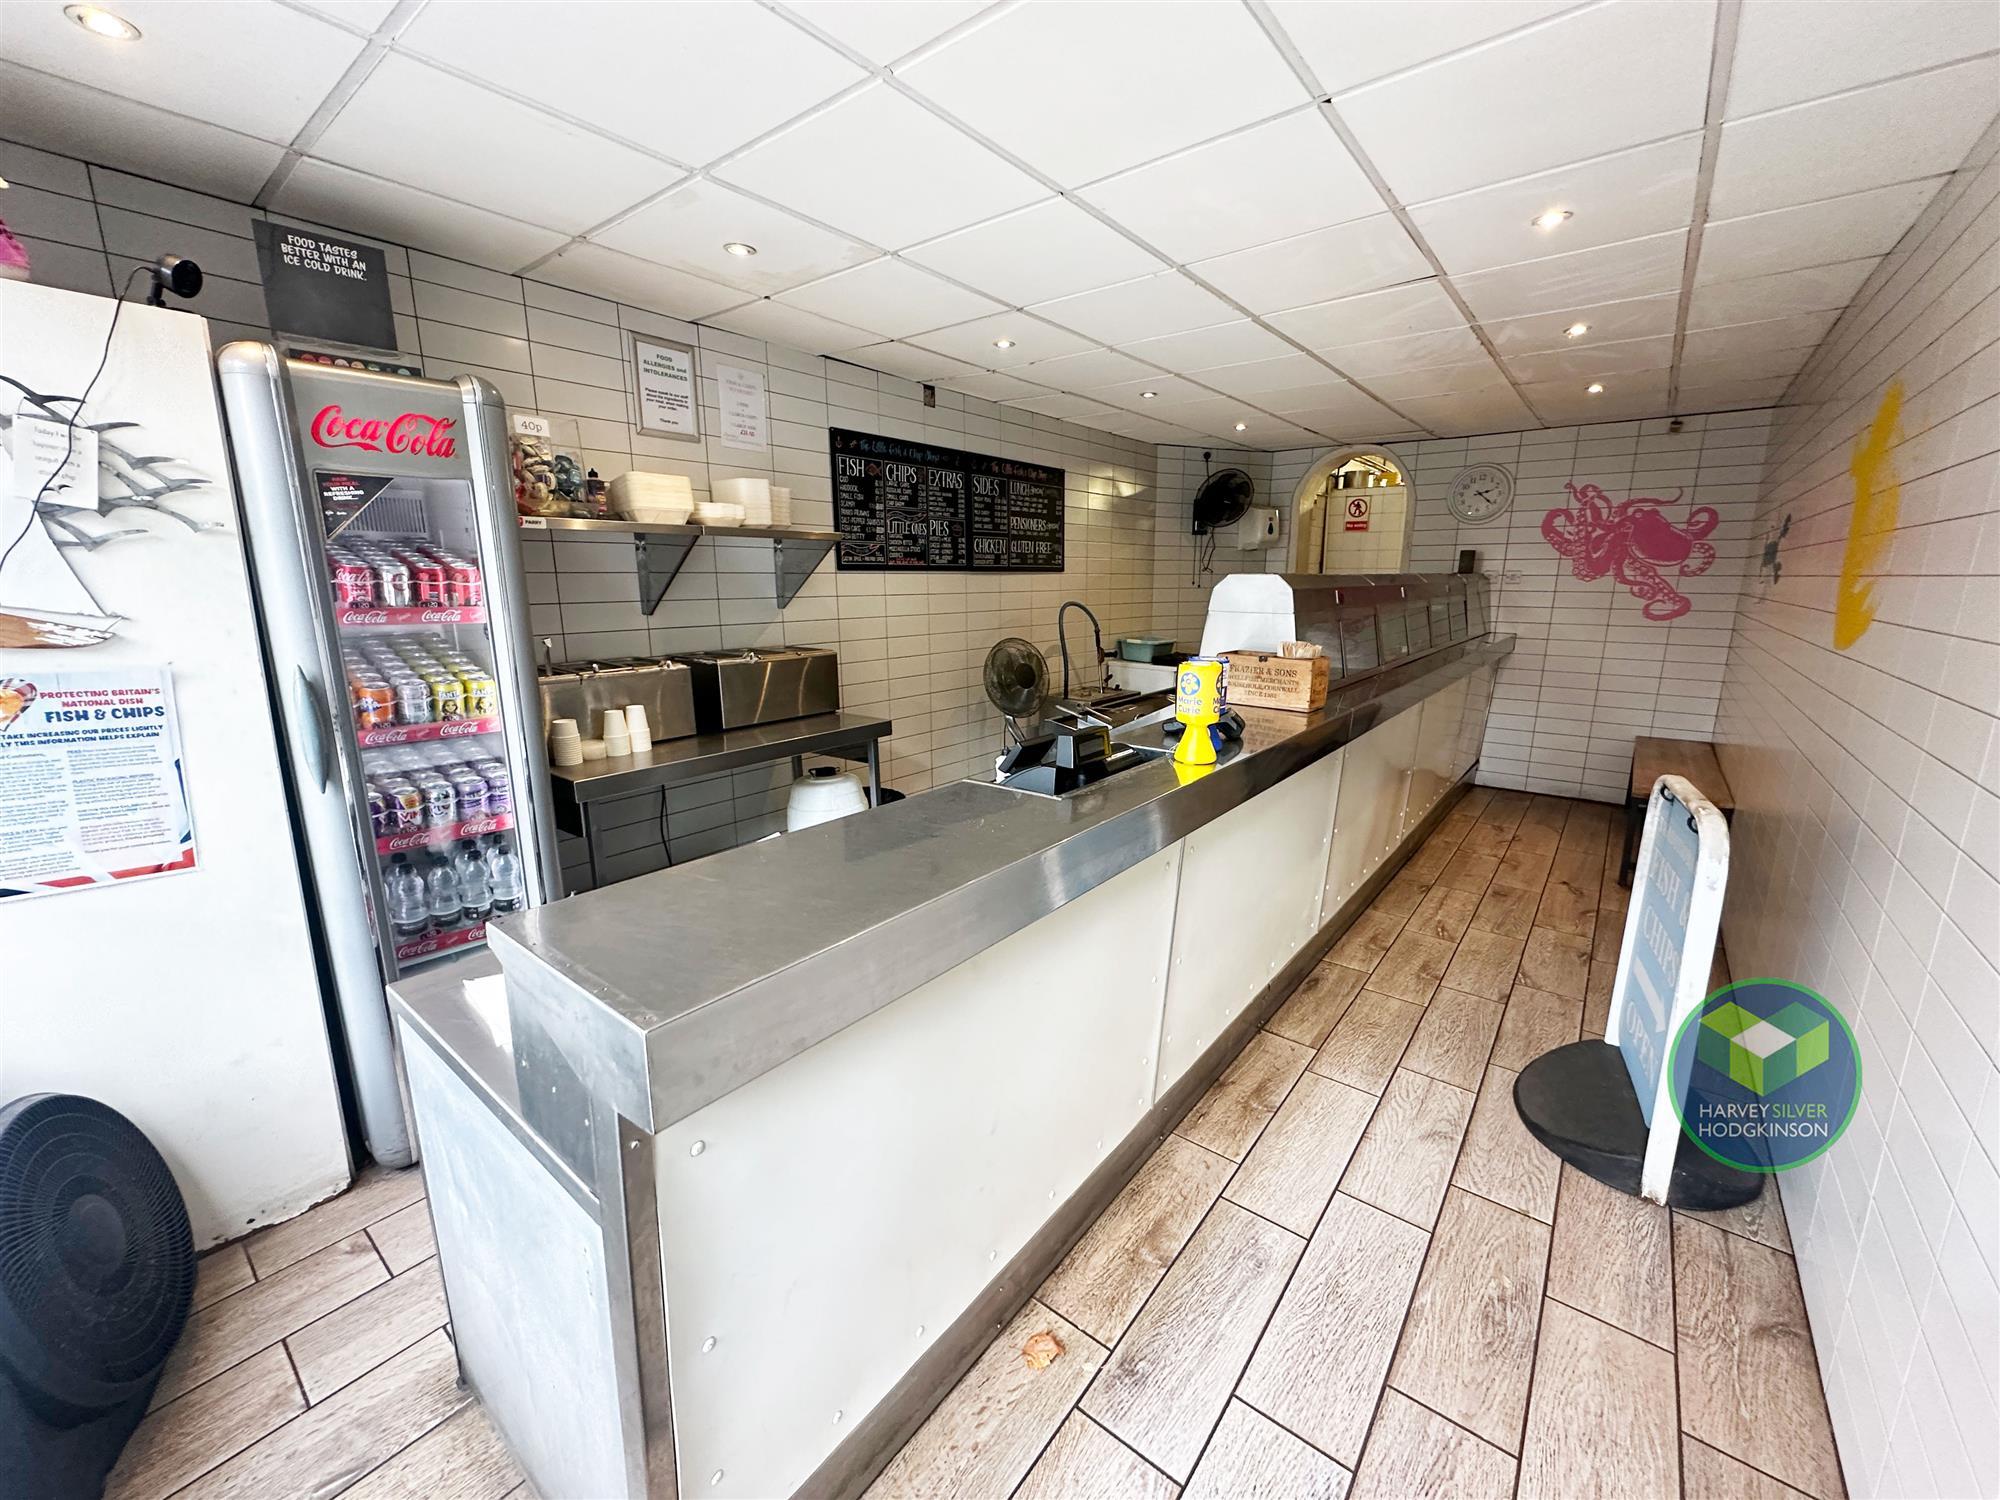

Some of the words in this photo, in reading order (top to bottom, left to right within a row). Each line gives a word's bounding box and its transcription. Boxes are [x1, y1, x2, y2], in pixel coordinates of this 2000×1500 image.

[287, 234, 316, 249] FOOD
[318, 242, 358, 260] TASTES
[280, 243, 320, 261] BETTER
[322, 252, 349, 268] WITH
[352, 260, 367, 272] AN
[283, 254, 301, 266] ICE
[304, 259, 331, 272] COLD
[333, 265, 368, 281] DRINK.
[643, 359, 676, 372] ALLERGIES
[656, 353, 673, 363] FOOD
[643, 367, 688, 382] INTOLERANCES
[311, 404, 458, 459] Coca-Cola
[520, 420, 543, 433] 40p
[838, 456, 865, 478] FISH
[885, 463, 917, 484] CHIPS
[928, 469, 964, 489] EXTRAS
[973, 476, 1000, 497] SIDES
[1010, 480, 1030, 496] LUNCH
[887, 520, 911, 535] LITTLE
[911, 522, 928, 535] ONES
[929, 519, 950, 537] PIES
[1010, 516, 1047, 531] PENSIONERS
[973, 538, 1007, 554] CHICKEN
[1010, 540, 1034, 554] GLUTEN
[1035, 541, 1053, 554] FREE
[343, 610, 388, 624] Coca-Cola
[421, 610, 463, 623] Coca-Cola
[1266, 667, 1272, 676] &
[1274, 668, 1298, 678] SONS
[40, 690, 109, 700] PROTECTING
[111, 688, 161, 697] BRITAIN'S
[1178, 696, 1203, 706] Marie
[61, 699, 116, 708] NATIONAL
[118, 697, 144, 706] DISH
[1178, 705, 1201, 714] Curie
[44, 710, 90, 723] FISH
[94, 708, 106, 721] &
[111, 706, 166, 720] CHIPS
[1, 733, 25, 741] TAKE
[27, 730, 81, 739] INCREASING
[82, 728, 99, 736] OUR
[101, 726, 130, 734] PRICES
[131, 724, 164, 732] LIGHTLY
[440, 721, 480, 736] Coca-Cola
[15, 739, 36, 747] THIS
[37, 735, 97, 745] INFORMATION
[126, 731, 160, 739] EXPLAIN
[460, 819, 498, 836] Coca-Cola
[1649, 847, 1682, 912] FISH
[1643, 904, 1683, 988] CHIPS
[1626, 1001, 1659, 1088] OPEN
